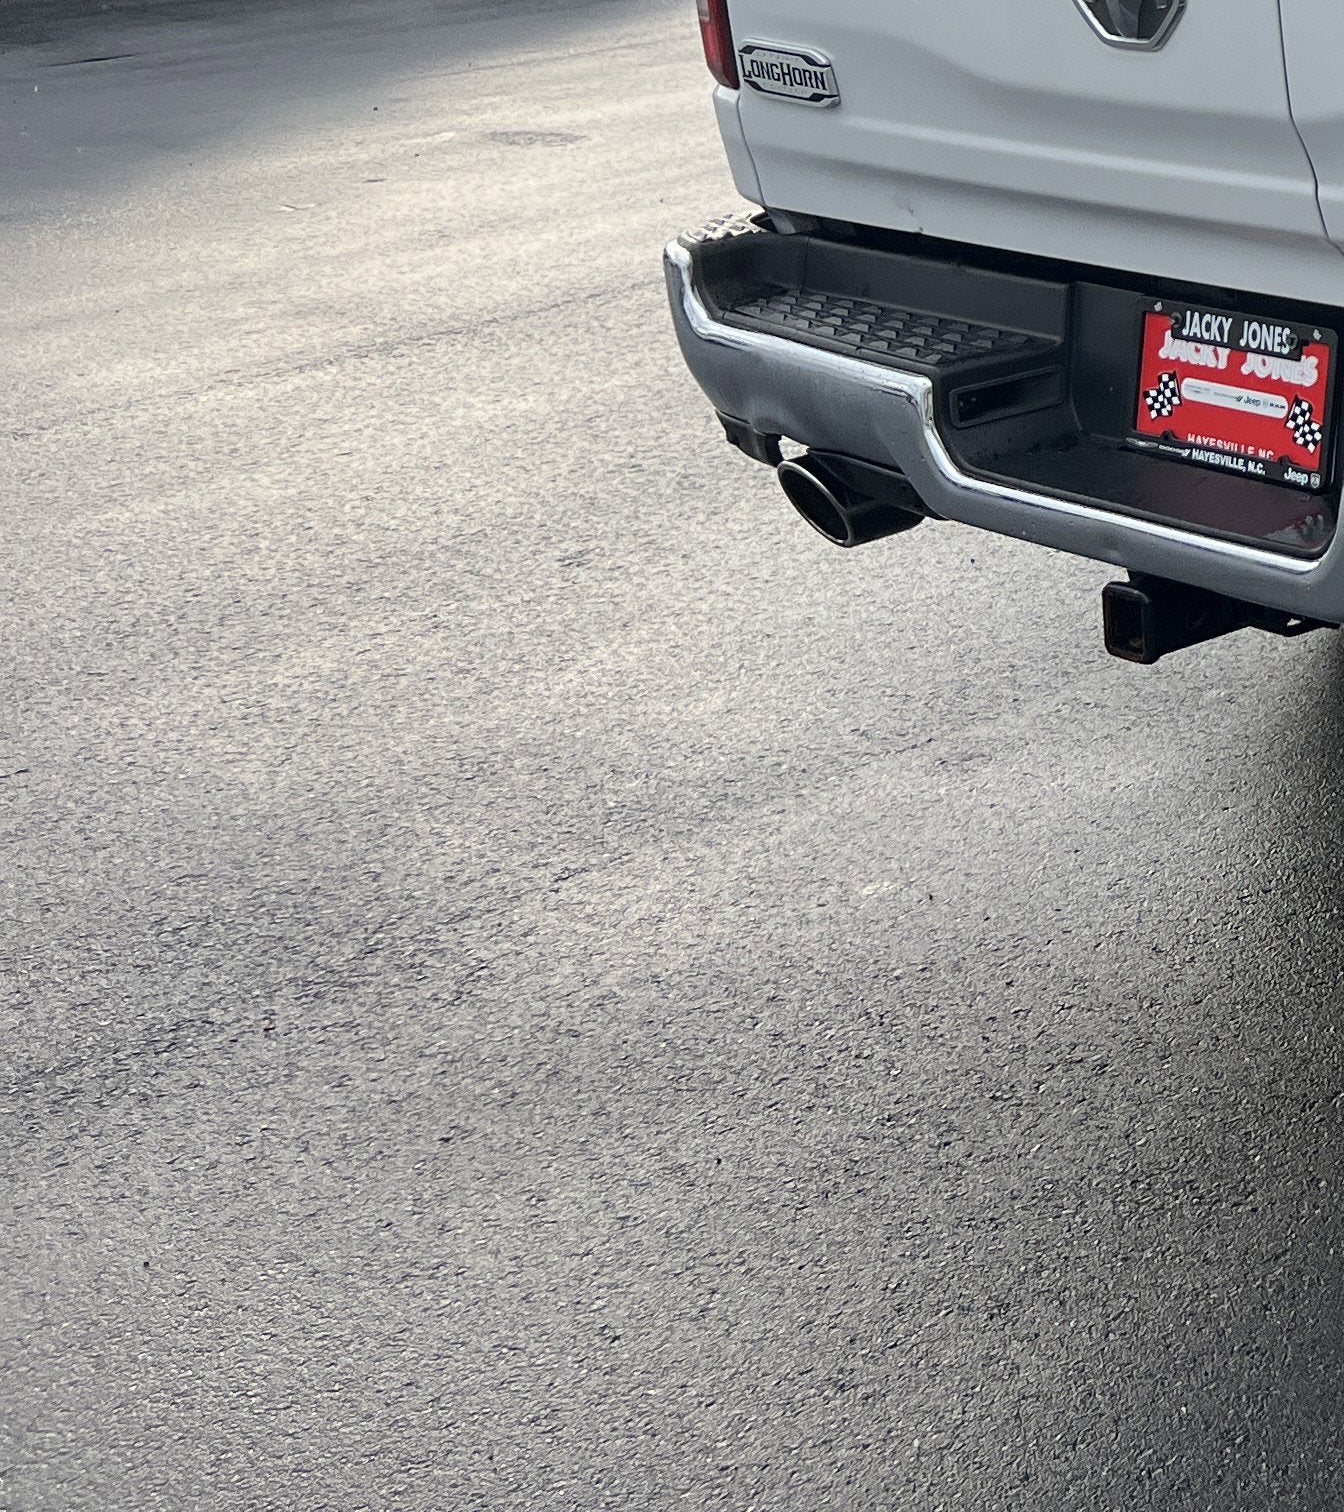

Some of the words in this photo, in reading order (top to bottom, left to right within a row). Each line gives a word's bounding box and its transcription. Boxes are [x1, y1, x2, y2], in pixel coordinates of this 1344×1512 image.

[738, 54, 828, 91] LONGHORN
[1182, 310, 1232, 344] JACKY
[1239, 320, 1291, 355] JONES
[1158, 330, 1231, 370] JACKY
[1240, 352, 1318, 387] JONES
[1191, 448, 1247, 473] HAYESVILLE,
[1248, 460, 1266, 476] N.C.
[1283, 467, 1309, 486] Jeep
